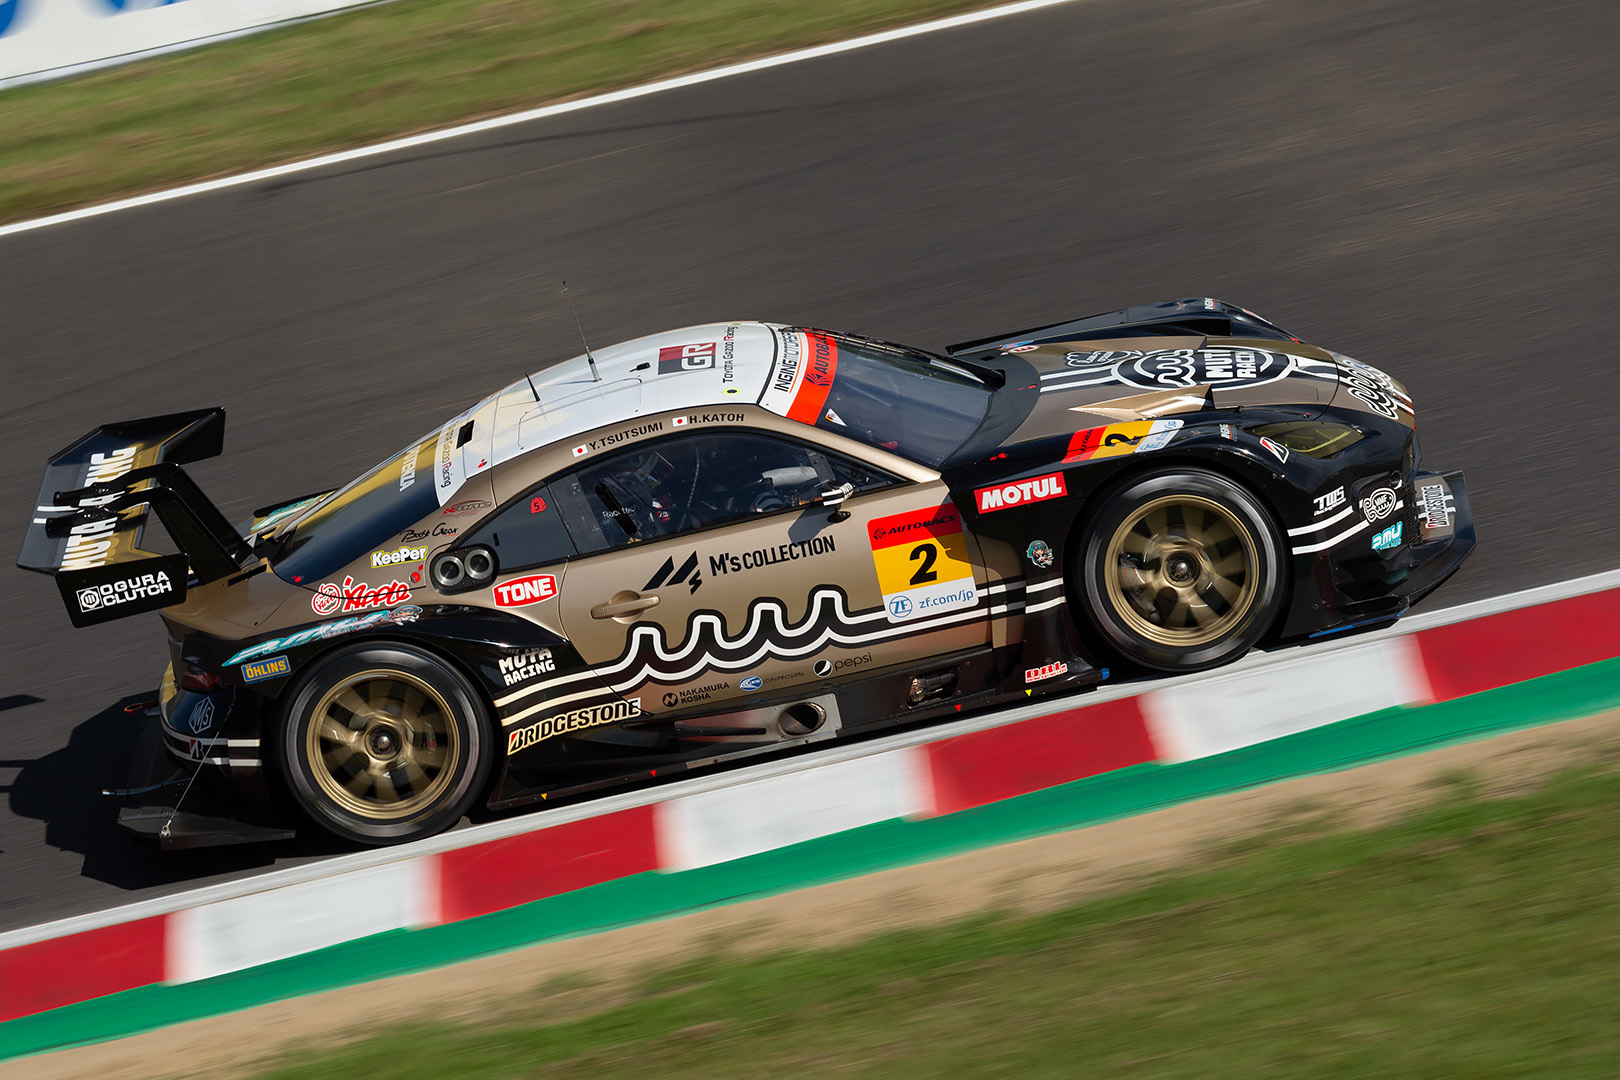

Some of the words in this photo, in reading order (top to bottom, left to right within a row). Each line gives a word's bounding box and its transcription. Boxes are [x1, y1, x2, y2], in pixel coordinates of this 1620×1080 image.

[681, 342, 713, 370] GR
[689, 413, 745, 425] H.KATOH
[589, 422, 663, 451] Y.TSUTSUMI
[400, 444, 422, 493] POTENZA
[441, 461, 453, 489] Racing
[533, 502, 540, 511] 5
[981, 477, 1062, 510] MOTUL
[399, 529, 430, 543] Boost
[432, 522, 459, 537] Gear
[888, 514, 956, 535] AUTOBACS
[371, 547, 427, 567] KeePer
[742, 535, 836, 570] COLLECTION
[909, 543, 938, 586] 2
[100, 570, 170, 596] OGURA
[103, 581, 172, 607] CLUTCH
[498, 577, 553, 604] TONE
[919, 588, 974, 609] zf.com/jp
[246, 660, 287, 679] ÖHLINS
[498, 647, 553, 675] MUTA
[503, 660, 556, 687] RACING
[834, 652, 873, 672] pepsi
[679, 682, 730, 697] NAKAMURA
[681, 692, 712, 704] KOSHA
[507, 697, 641, 755] BRIDGESTONE
